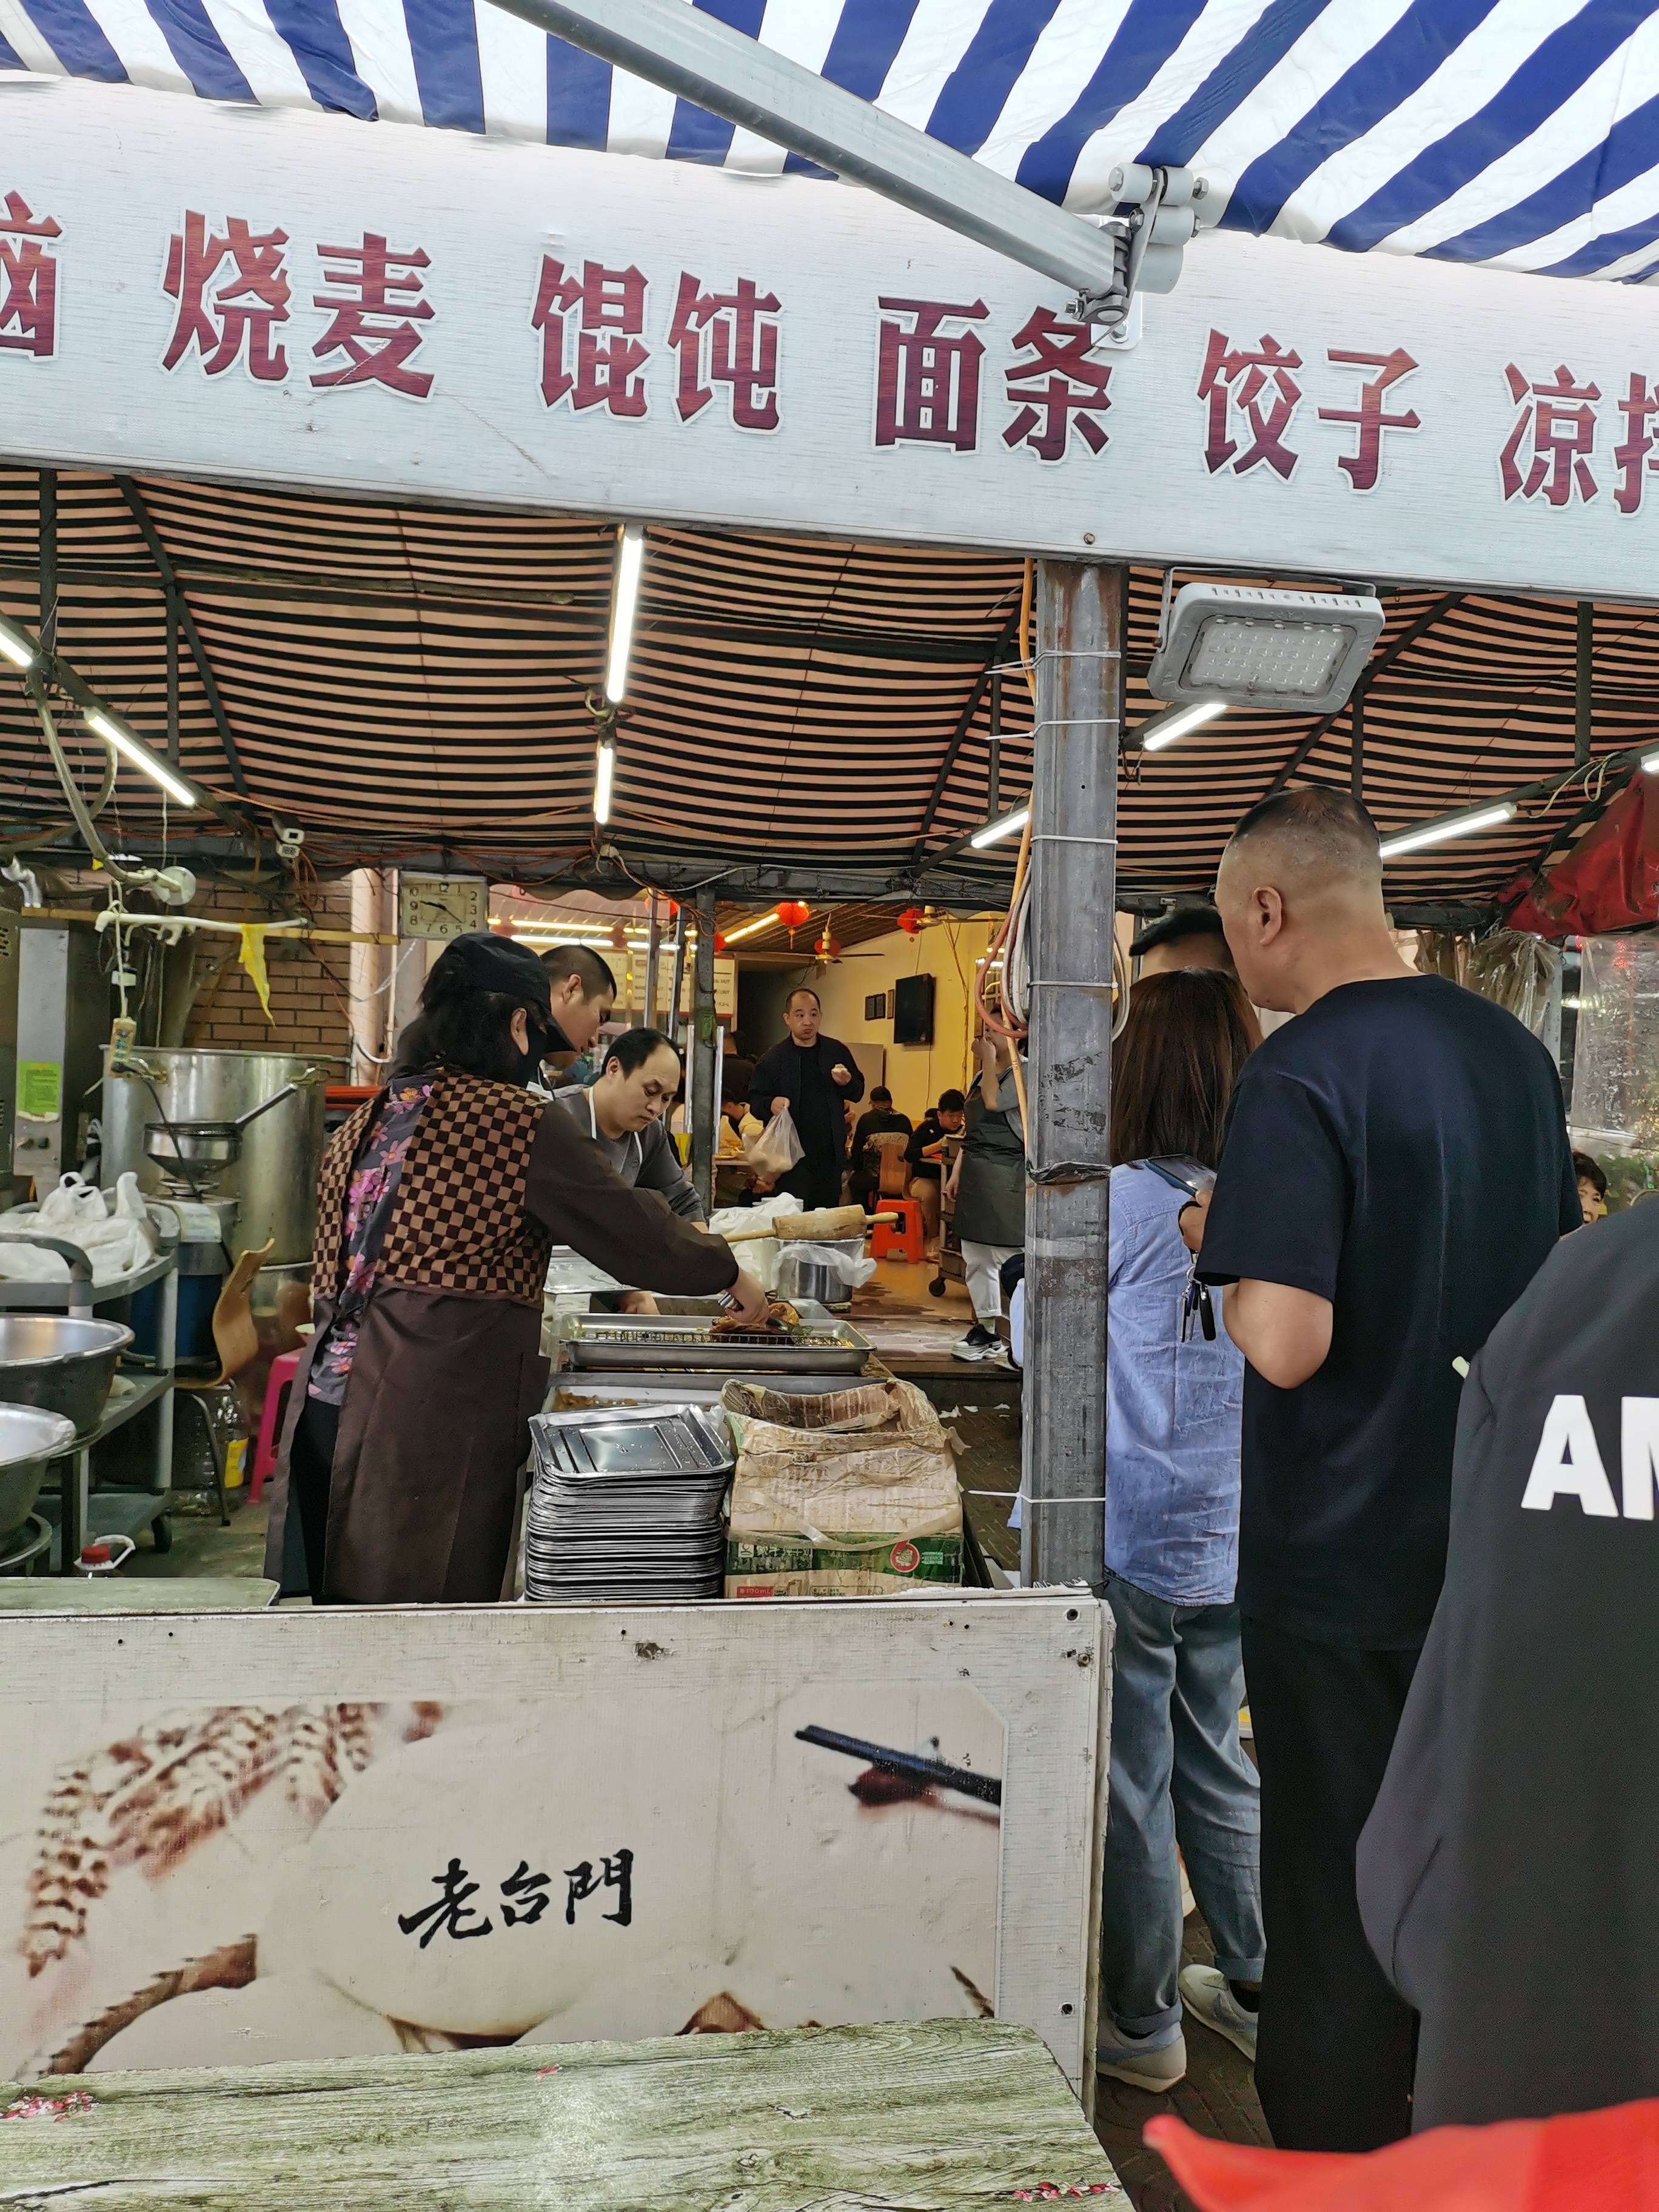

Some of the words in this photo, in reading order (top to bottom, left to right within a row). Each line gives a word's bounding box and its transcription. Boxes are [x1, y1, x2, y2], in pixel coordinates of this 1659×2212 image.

[163, 210, 436, 398] 烧麦
[531, 254, 782, 429] 馄饨
[876, 297, 1113, 460] 面条
[1197, 328, 1421, 489] 饺子
[409, 886, 419, 897] 10
[470, 891, 478, 901] 2
[410, 901, 418, 910] 9
[470, 905, 477, 914] 3
[410, 915, 418, 925] 8
[469, 919, 477, 929] 4
[440, 924, 447, 934] 6
[398, 1849, 634, 1949] 老台門
